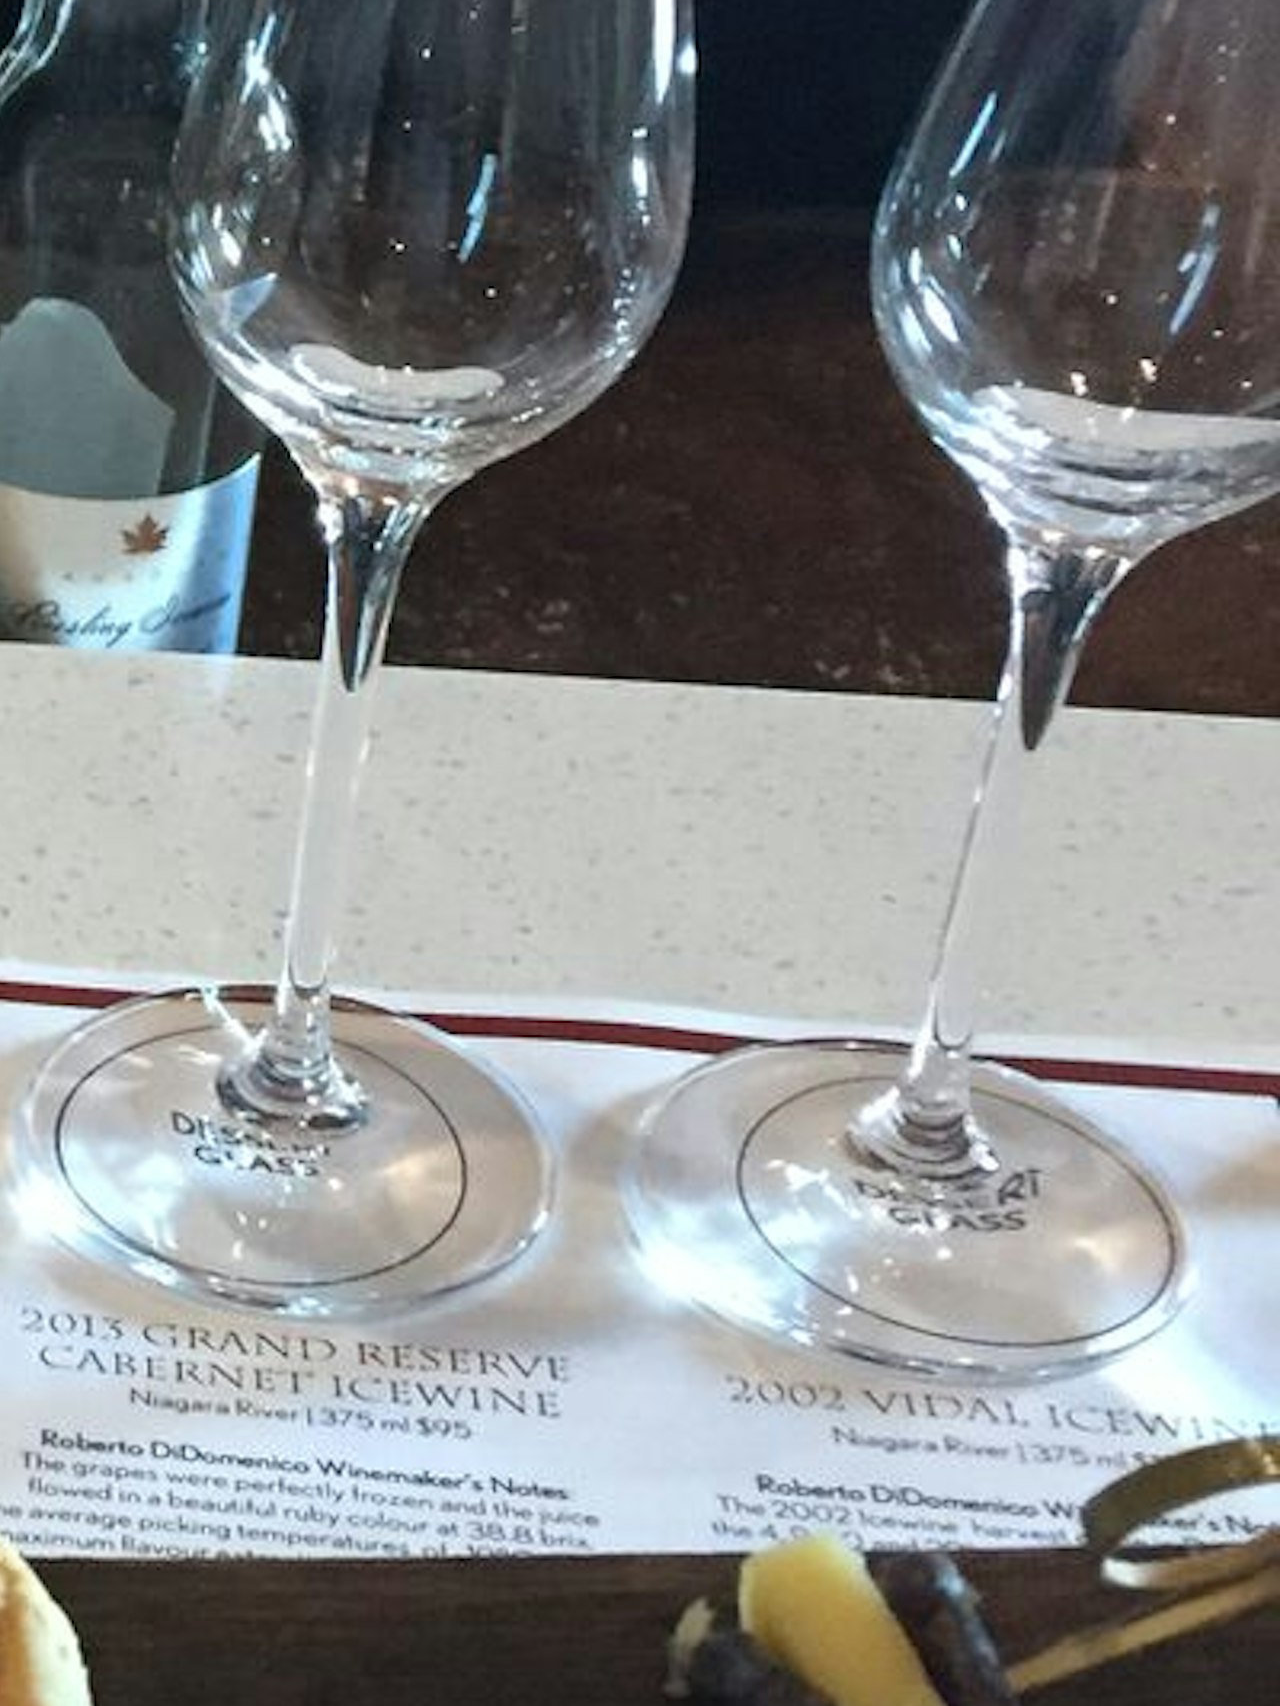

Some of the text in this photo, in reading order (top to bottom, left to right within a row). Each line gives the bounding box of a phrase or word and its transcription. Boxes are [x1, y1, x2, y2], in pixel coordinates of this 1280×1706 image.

[142, 1321, 337, 1361] GRAND
[358, 1341, 570, 1383] RESERVE
[40, 1345, 561, 1419] CABERNET ICEWINE
[725, 1374, 846, 1412] 2002
[865, 1389, 1029, 1428] VIDAL
[130, 1387, 231, 1415] Niagara
[235, 1398, 298, 1423] River
[320, 1407, 375, 1432] 375
[415, 1416, 473, 1440] $95
[40, 1428, 570, 1500] Roberto DiDomenico Winemaker's Notes
[831, 1426, 938, 1453] Niagara
[943, 1435, 1009, 1457] River
[22, 1450, 600, 1528] The grapes were perfectly frozen and the juice
[28, 1476, 114, 1502] flowed
[118, 1489, 143, 1504] in
[167, 1490, 277, 1519] beautiful
[283, 1504, 340, 1528] ruby
[347, 1513, 429, 1534] colour
[436, 1521, 460, 1538] at
[717, 1493, 766, 1516] The
[770, 1500, 851, 1525] 2002
[856, 1508, 959, 1533] Icewine
[754, 1473, 867, 1502] Roberto
[870, 1484, 1038, 1517] DiDomenico
[28, 1505, 133, 1531] average
[138, 1514, 233, 1541] picking
[237, 1521, 410, 1557] temperatures
